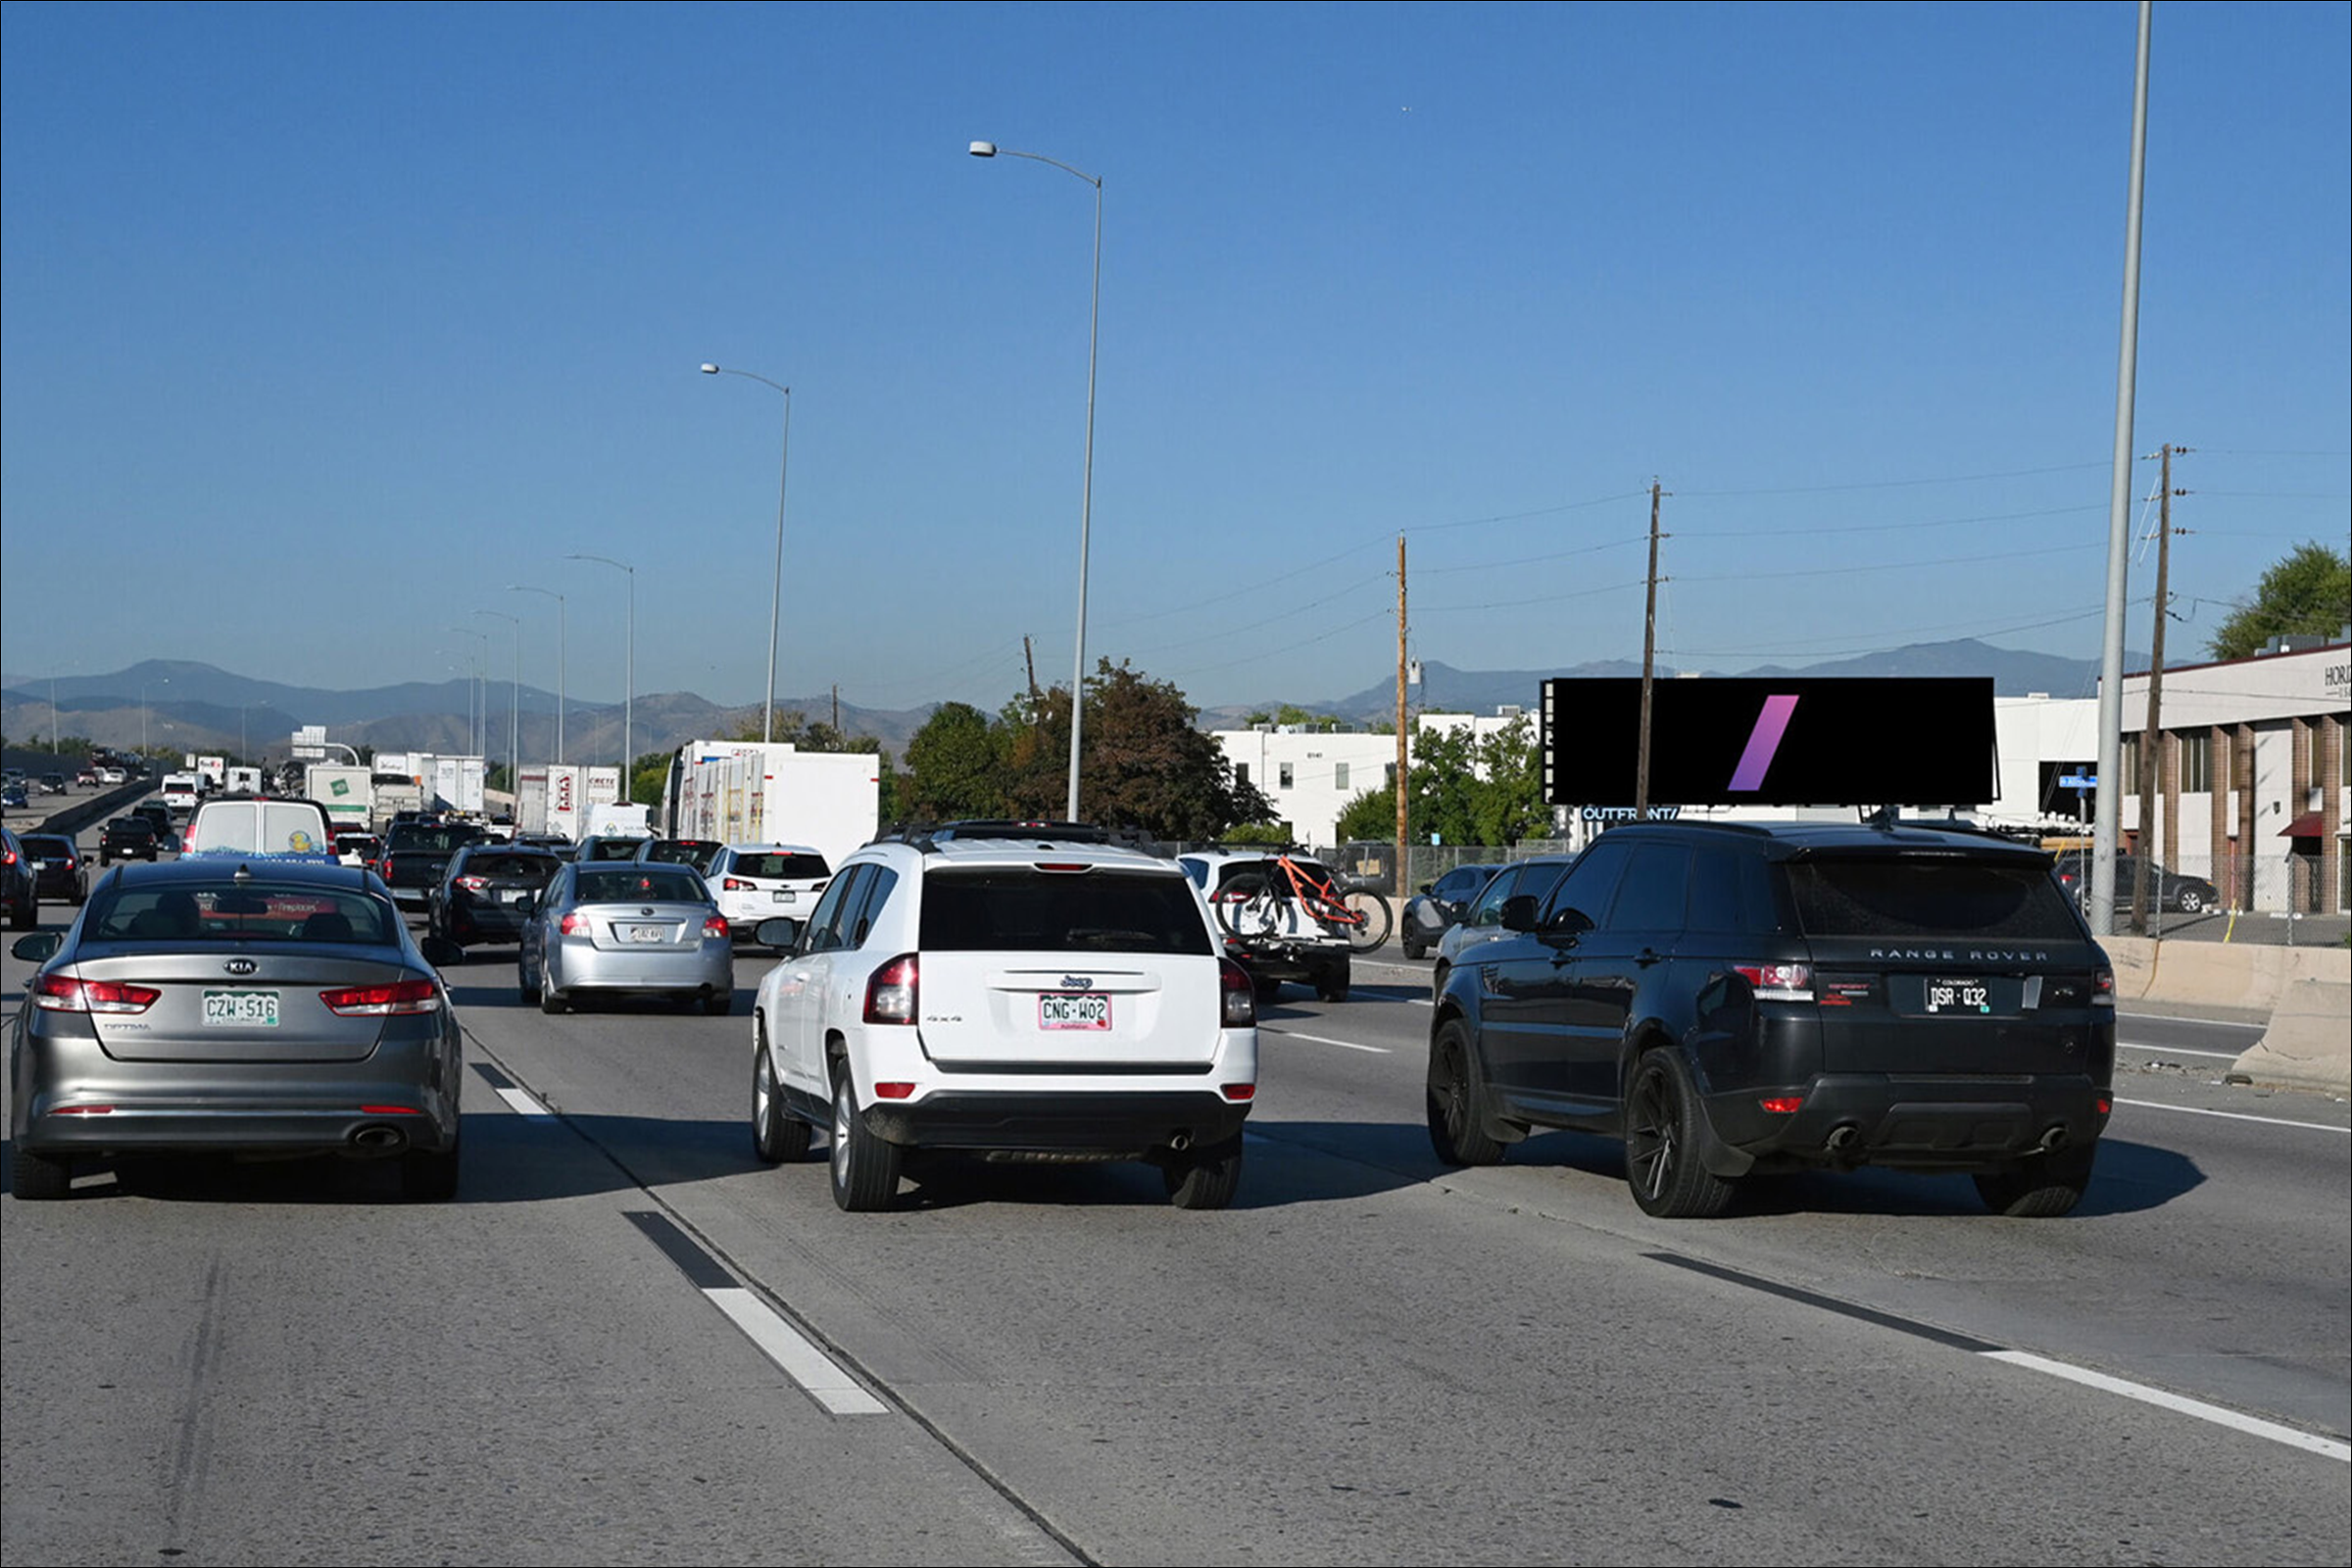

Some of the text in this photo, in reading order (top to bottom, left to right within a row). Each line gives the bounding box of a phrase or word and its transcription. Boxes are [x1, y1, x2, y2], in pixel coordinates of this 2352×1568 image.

[1583, 808, 1677, 820] OUTFRNT/
[1870, 949, 2048, 960] RANGE ROVER
[229, 962, 253, 972] KIA
[1059, 974, 1094, 990] Jeep
